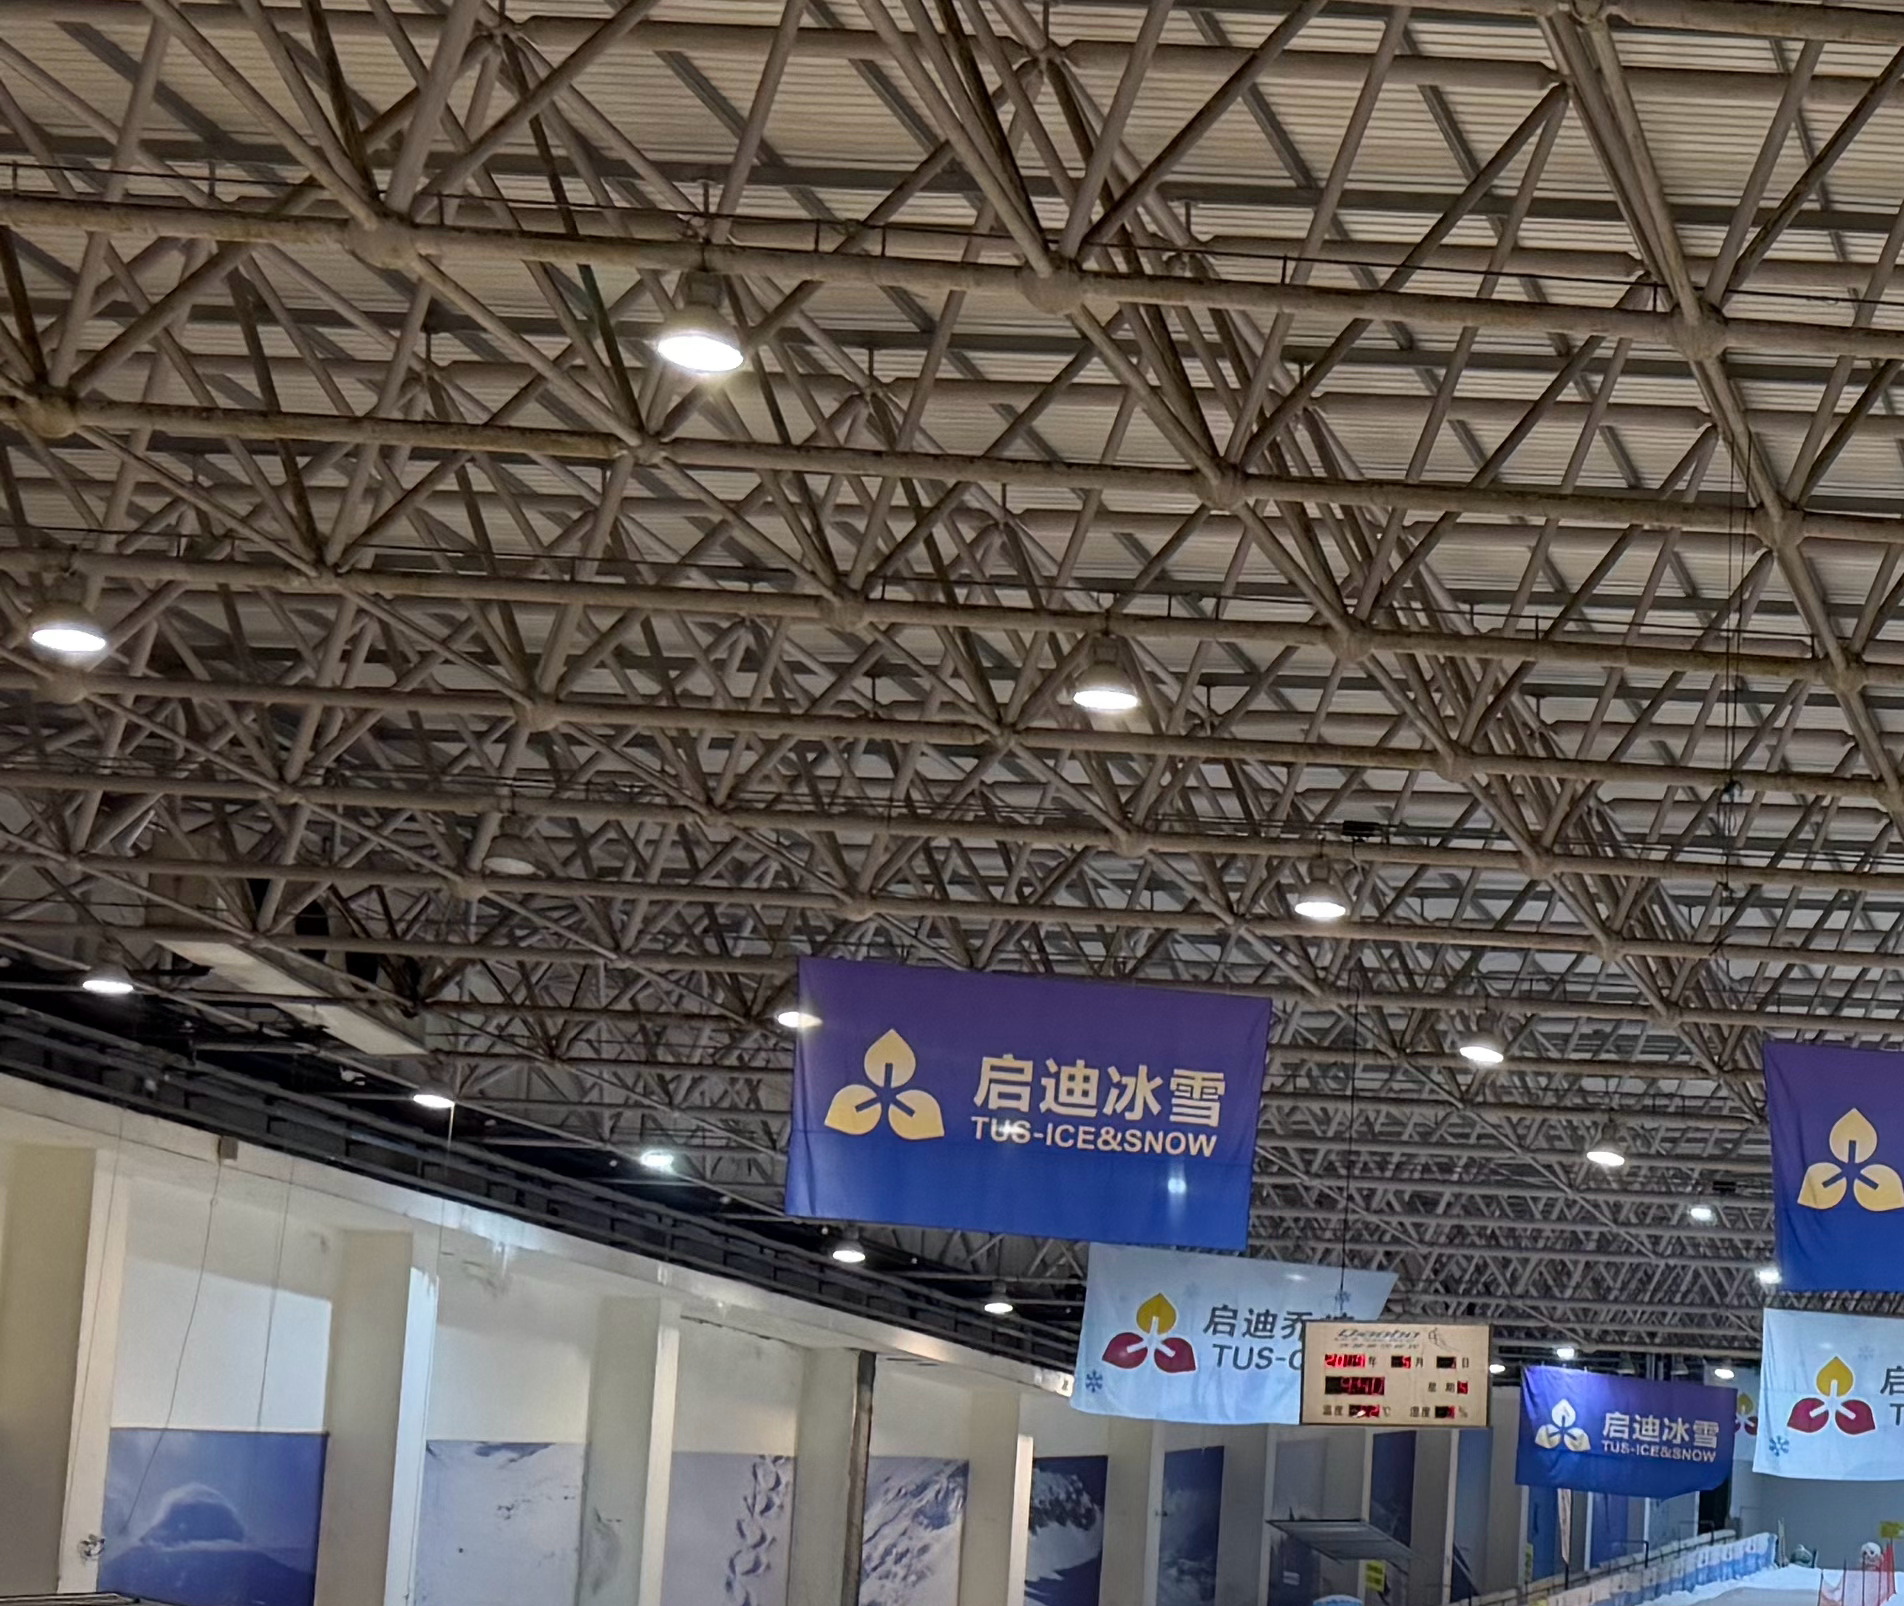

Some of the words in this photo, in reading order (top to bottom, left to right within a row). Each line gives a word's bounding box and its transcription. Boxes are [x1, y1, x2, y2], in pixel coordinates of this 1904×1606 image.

[974, 1053, 1226, 1127] 启迪冰雪
[971, 1116, 1218, 1158] TUS-ICE&SNOW
[1203, 1303, 1354, 1340] 启迪乔
[1602, 1411, 1719, 1449] 启迪冰雪
[1602, 1441, 1716, 1463] TUS-ICE&SNOW
